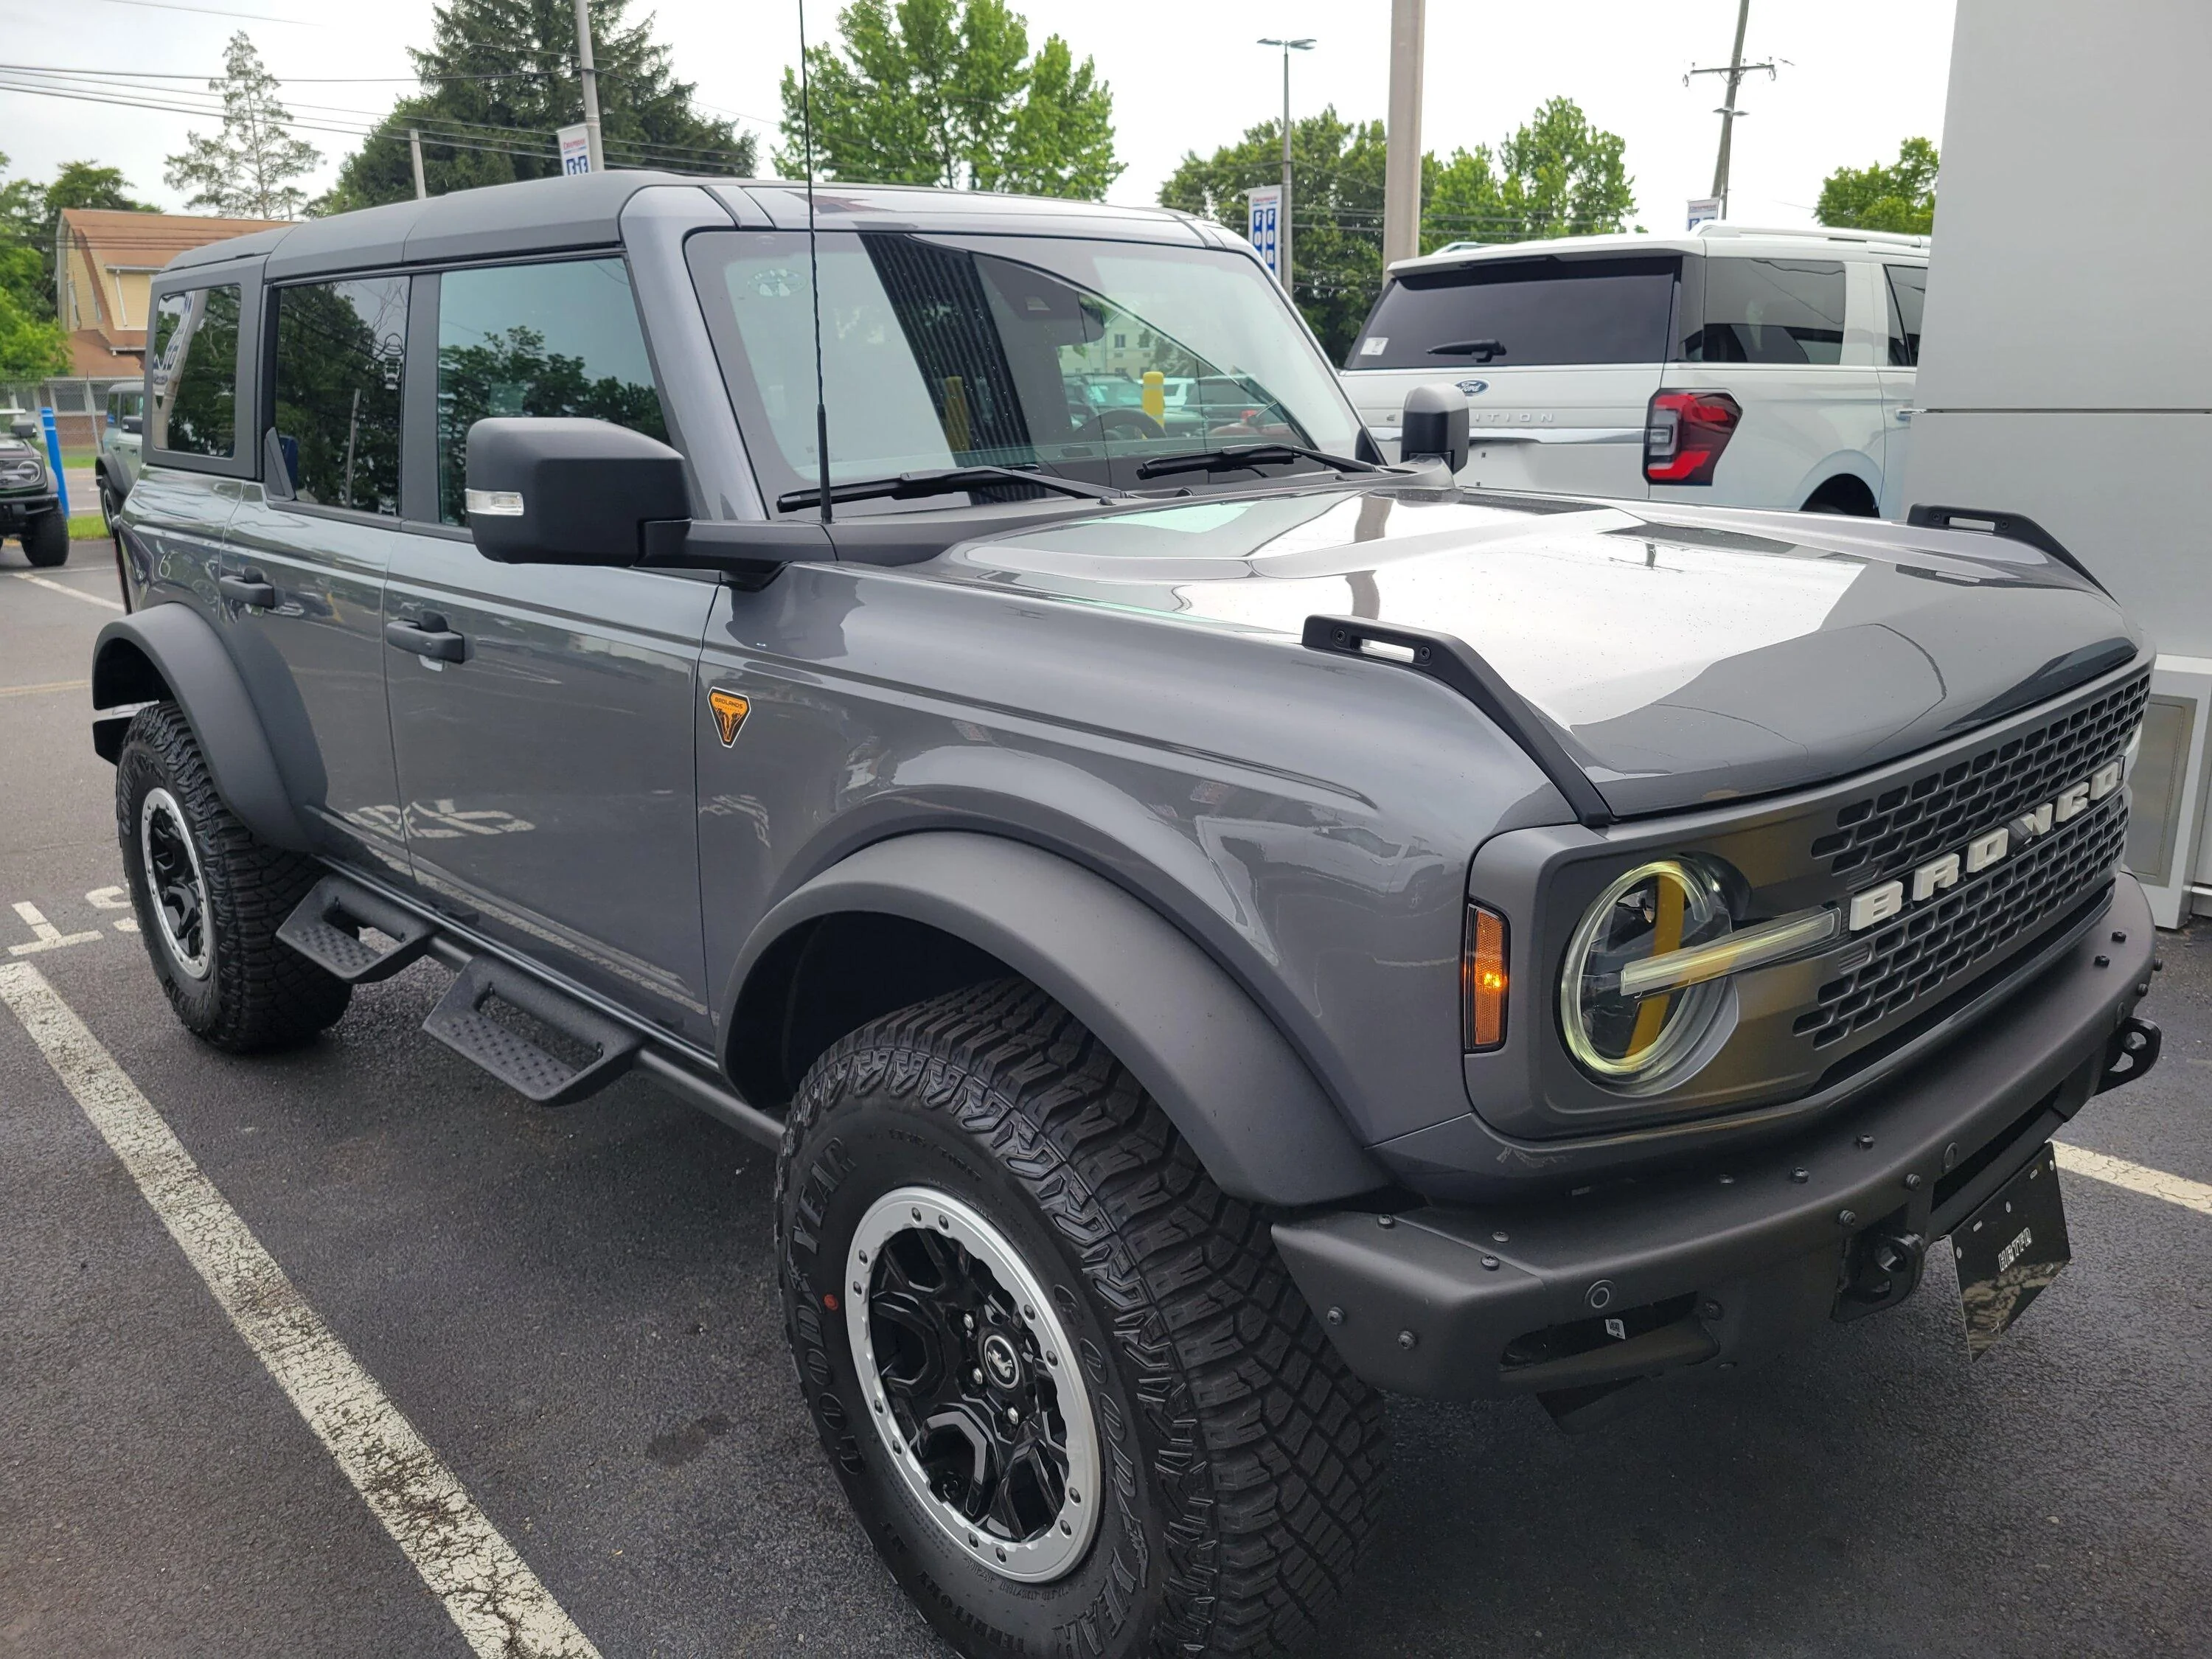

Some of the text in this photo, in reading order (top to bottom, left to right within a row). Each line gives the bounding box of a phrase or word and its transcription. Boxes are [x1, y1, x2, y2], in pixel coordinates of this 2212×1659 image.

[1461, 380, 1483, 392] Ford
[714, 697, 744, 709] BADLANDS
[1848, 761, 2119, 931] BRONCO
